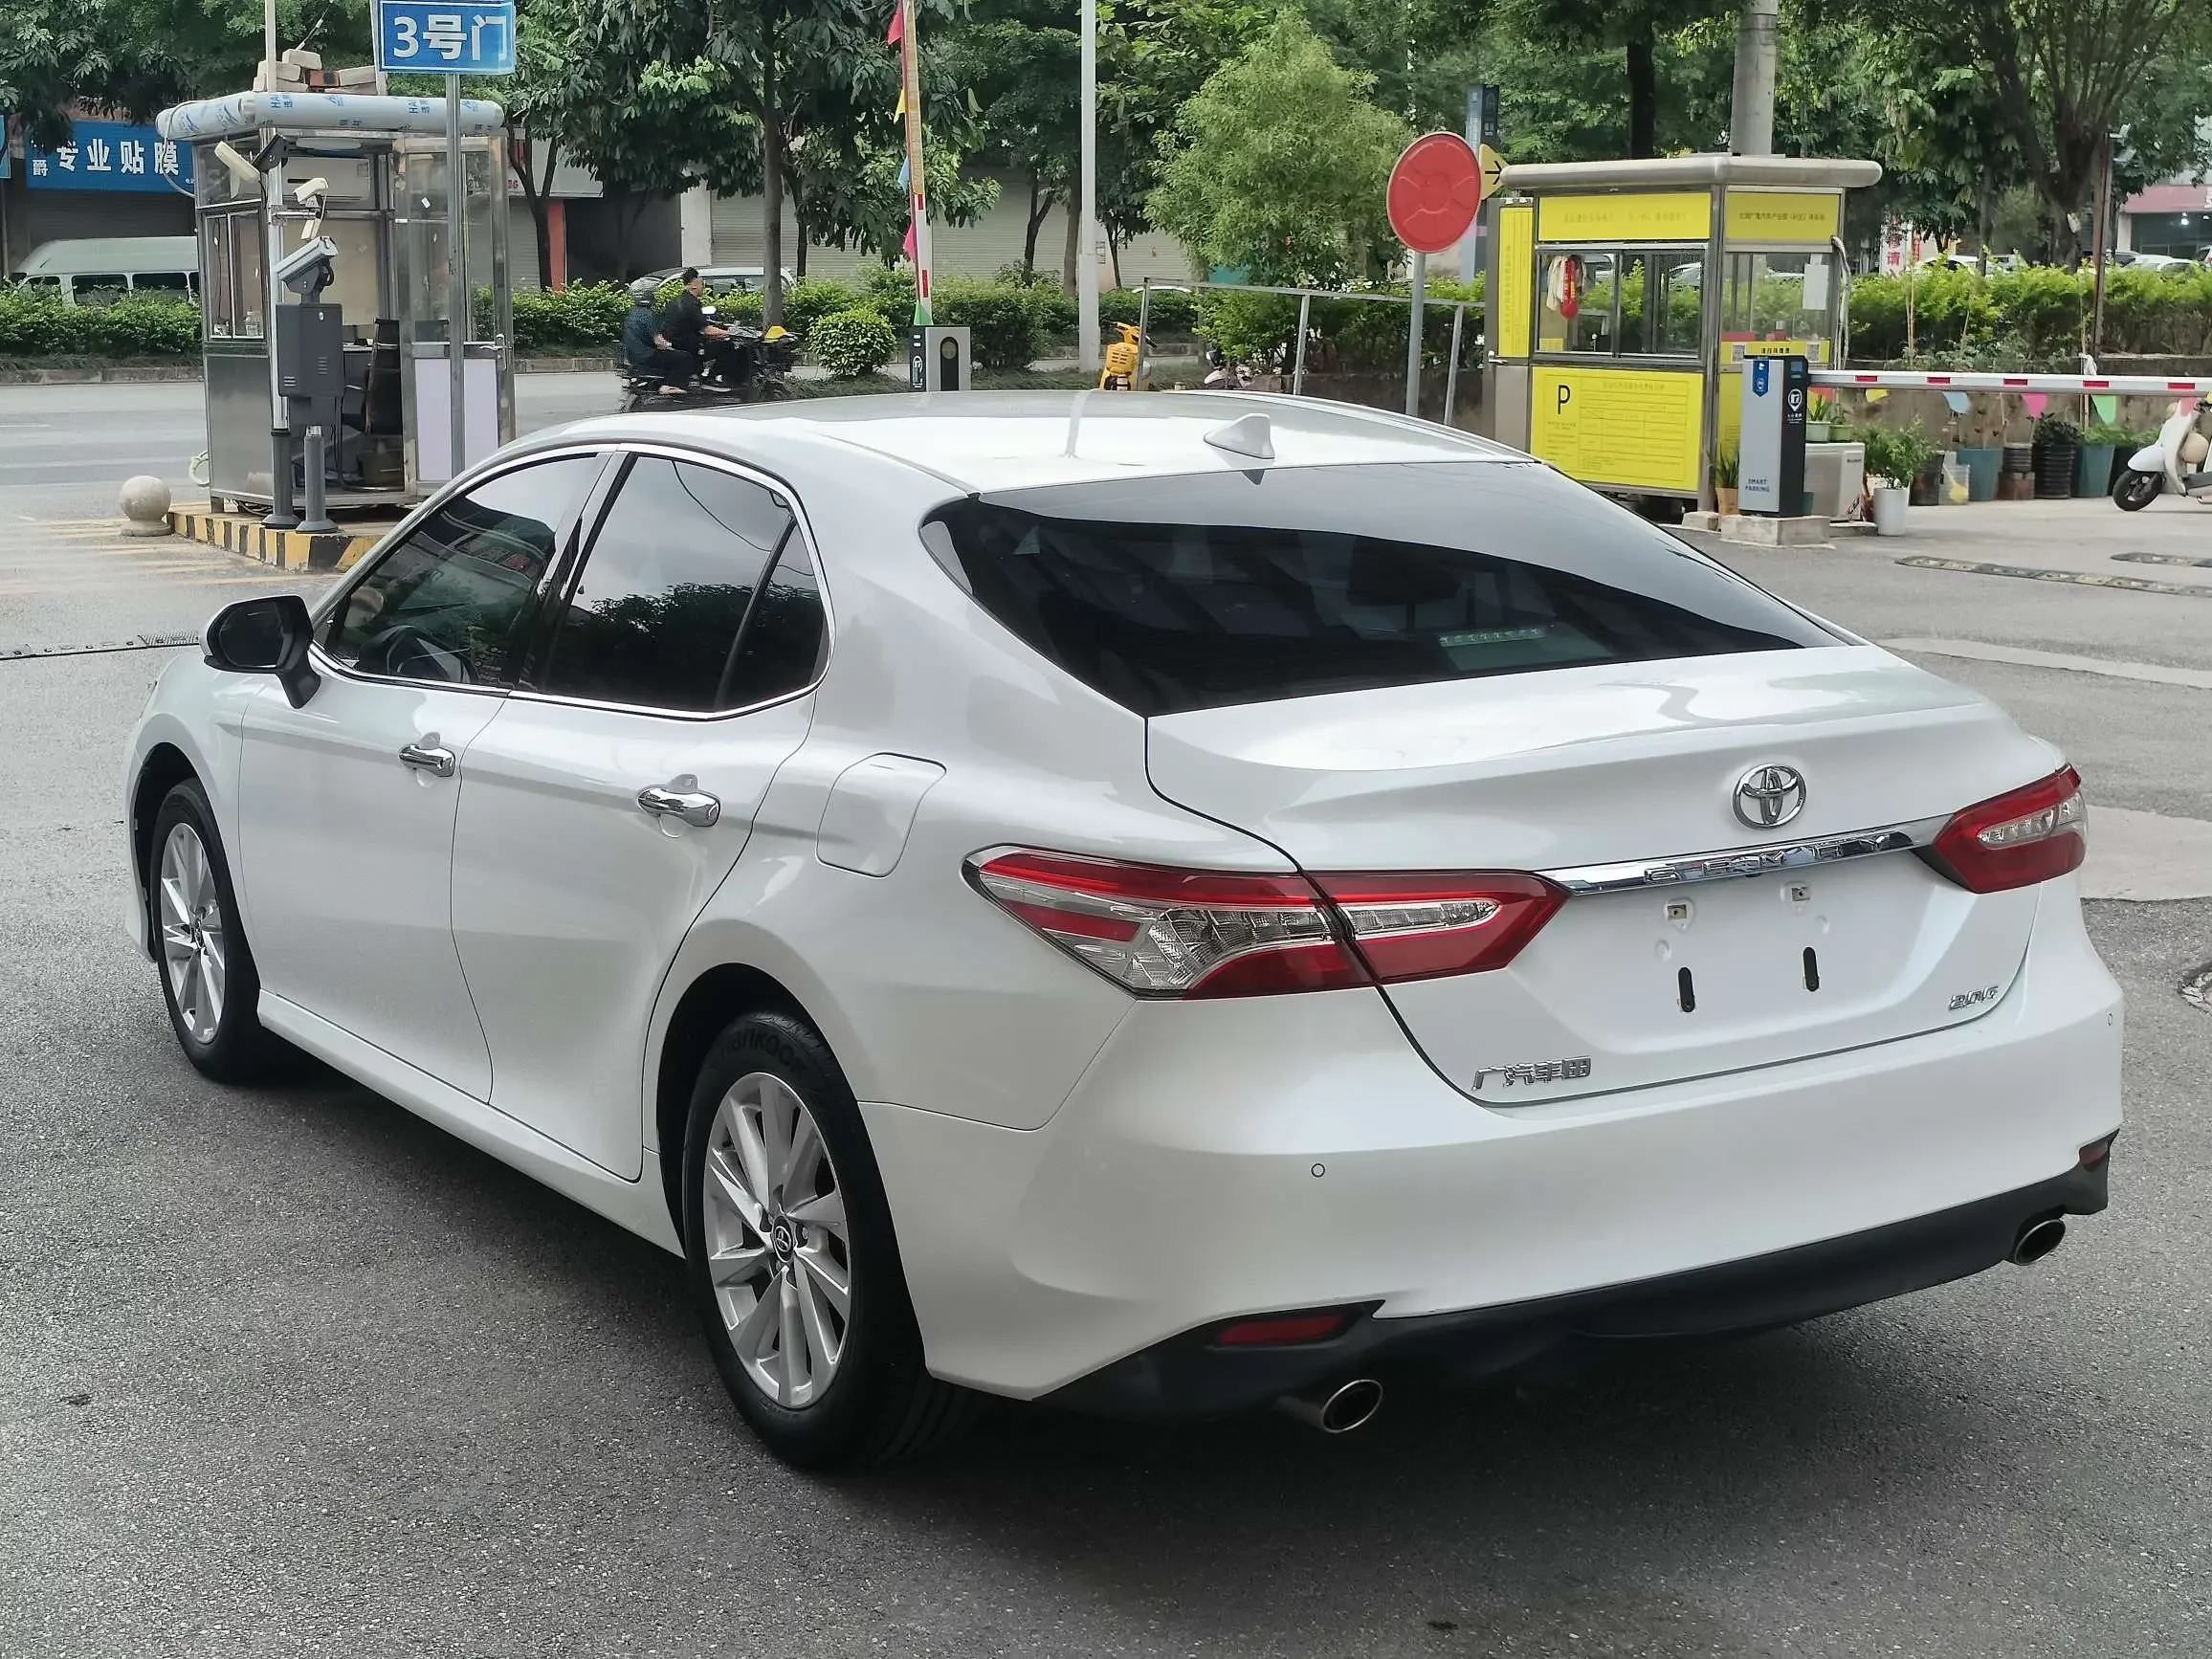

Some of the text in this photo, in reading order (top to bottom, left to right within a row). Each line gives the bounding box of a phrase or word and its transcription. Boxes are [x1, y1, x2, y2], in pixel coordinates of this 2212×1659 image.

[393, 13, 508, 61] 3号门
[55, 138, 180, 176] 专业贴膜
[1557, 384, 1571, 415] P
